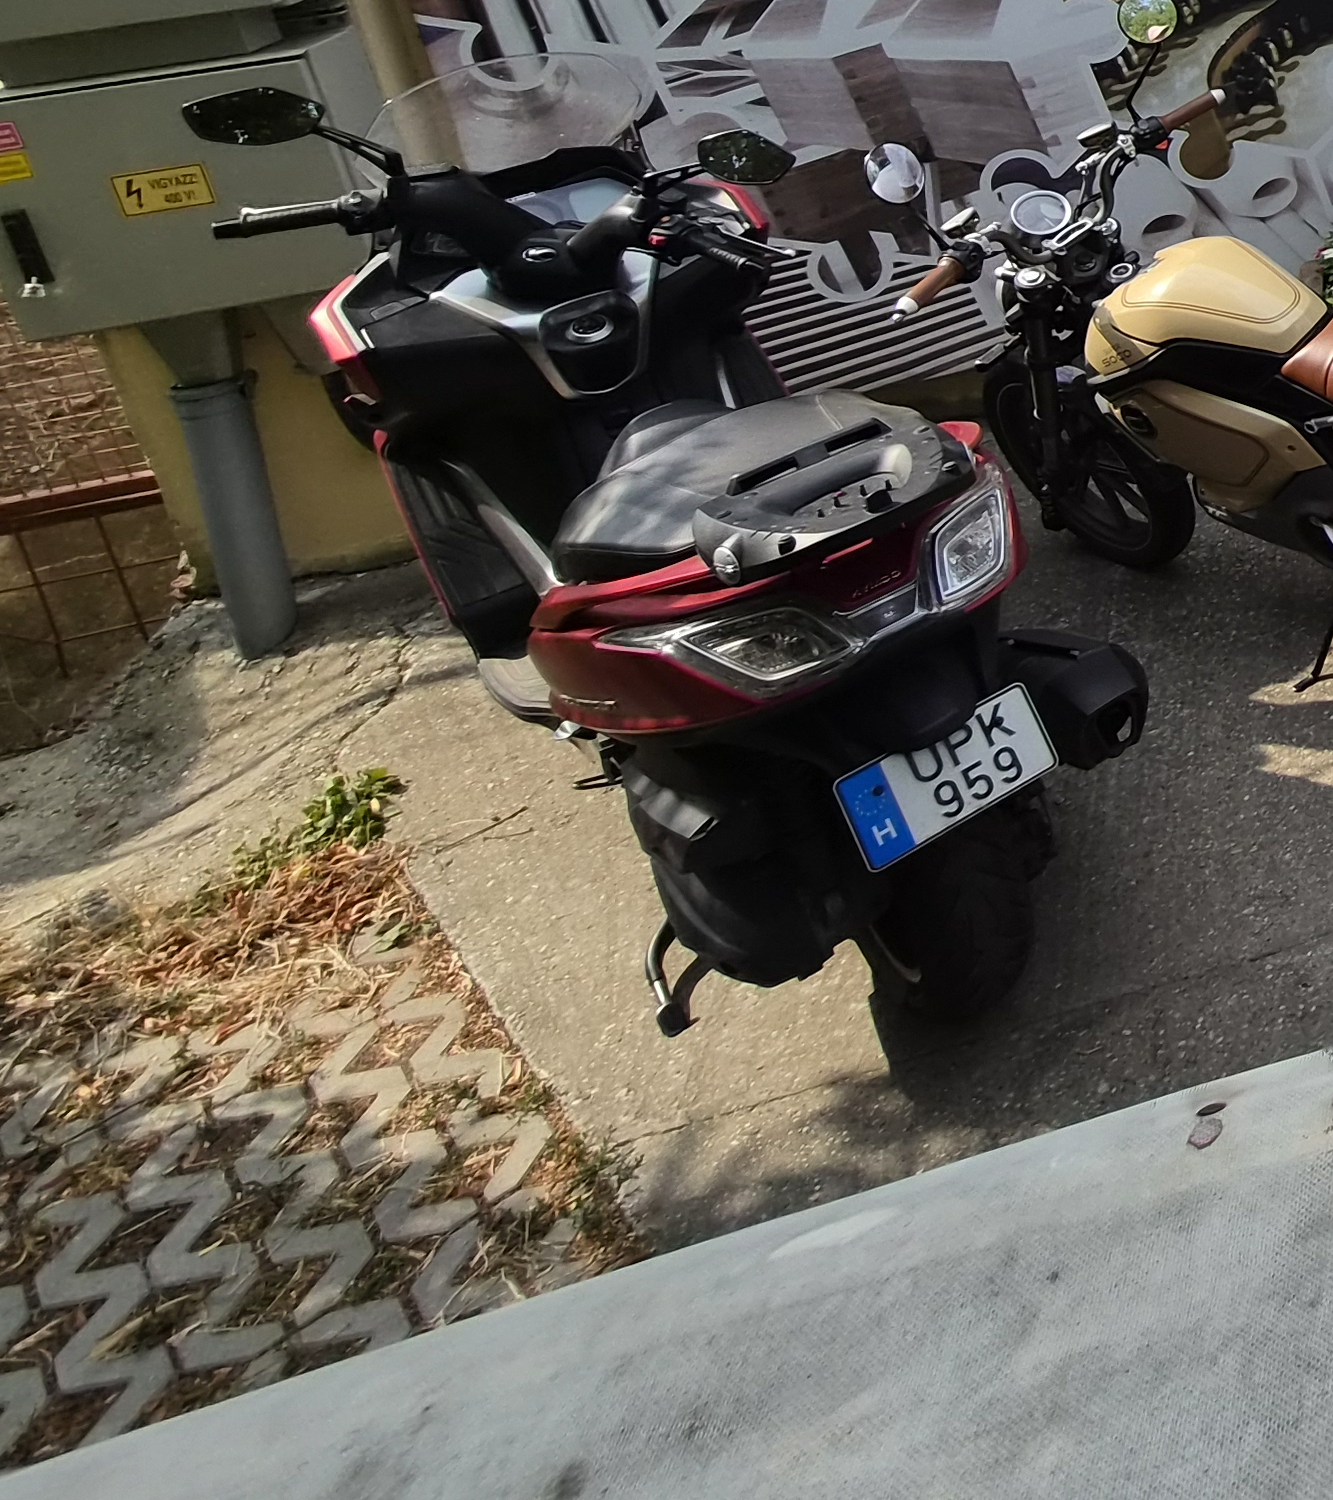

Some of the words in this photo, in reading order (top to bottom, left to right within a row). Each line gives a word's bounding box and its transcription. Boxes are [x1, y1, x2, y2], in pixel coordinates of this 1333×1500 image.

[1102, 349, 1132, 368] SOCO
[933, 746, 1023, 818] 959
[871, 817, 898, 847] H
